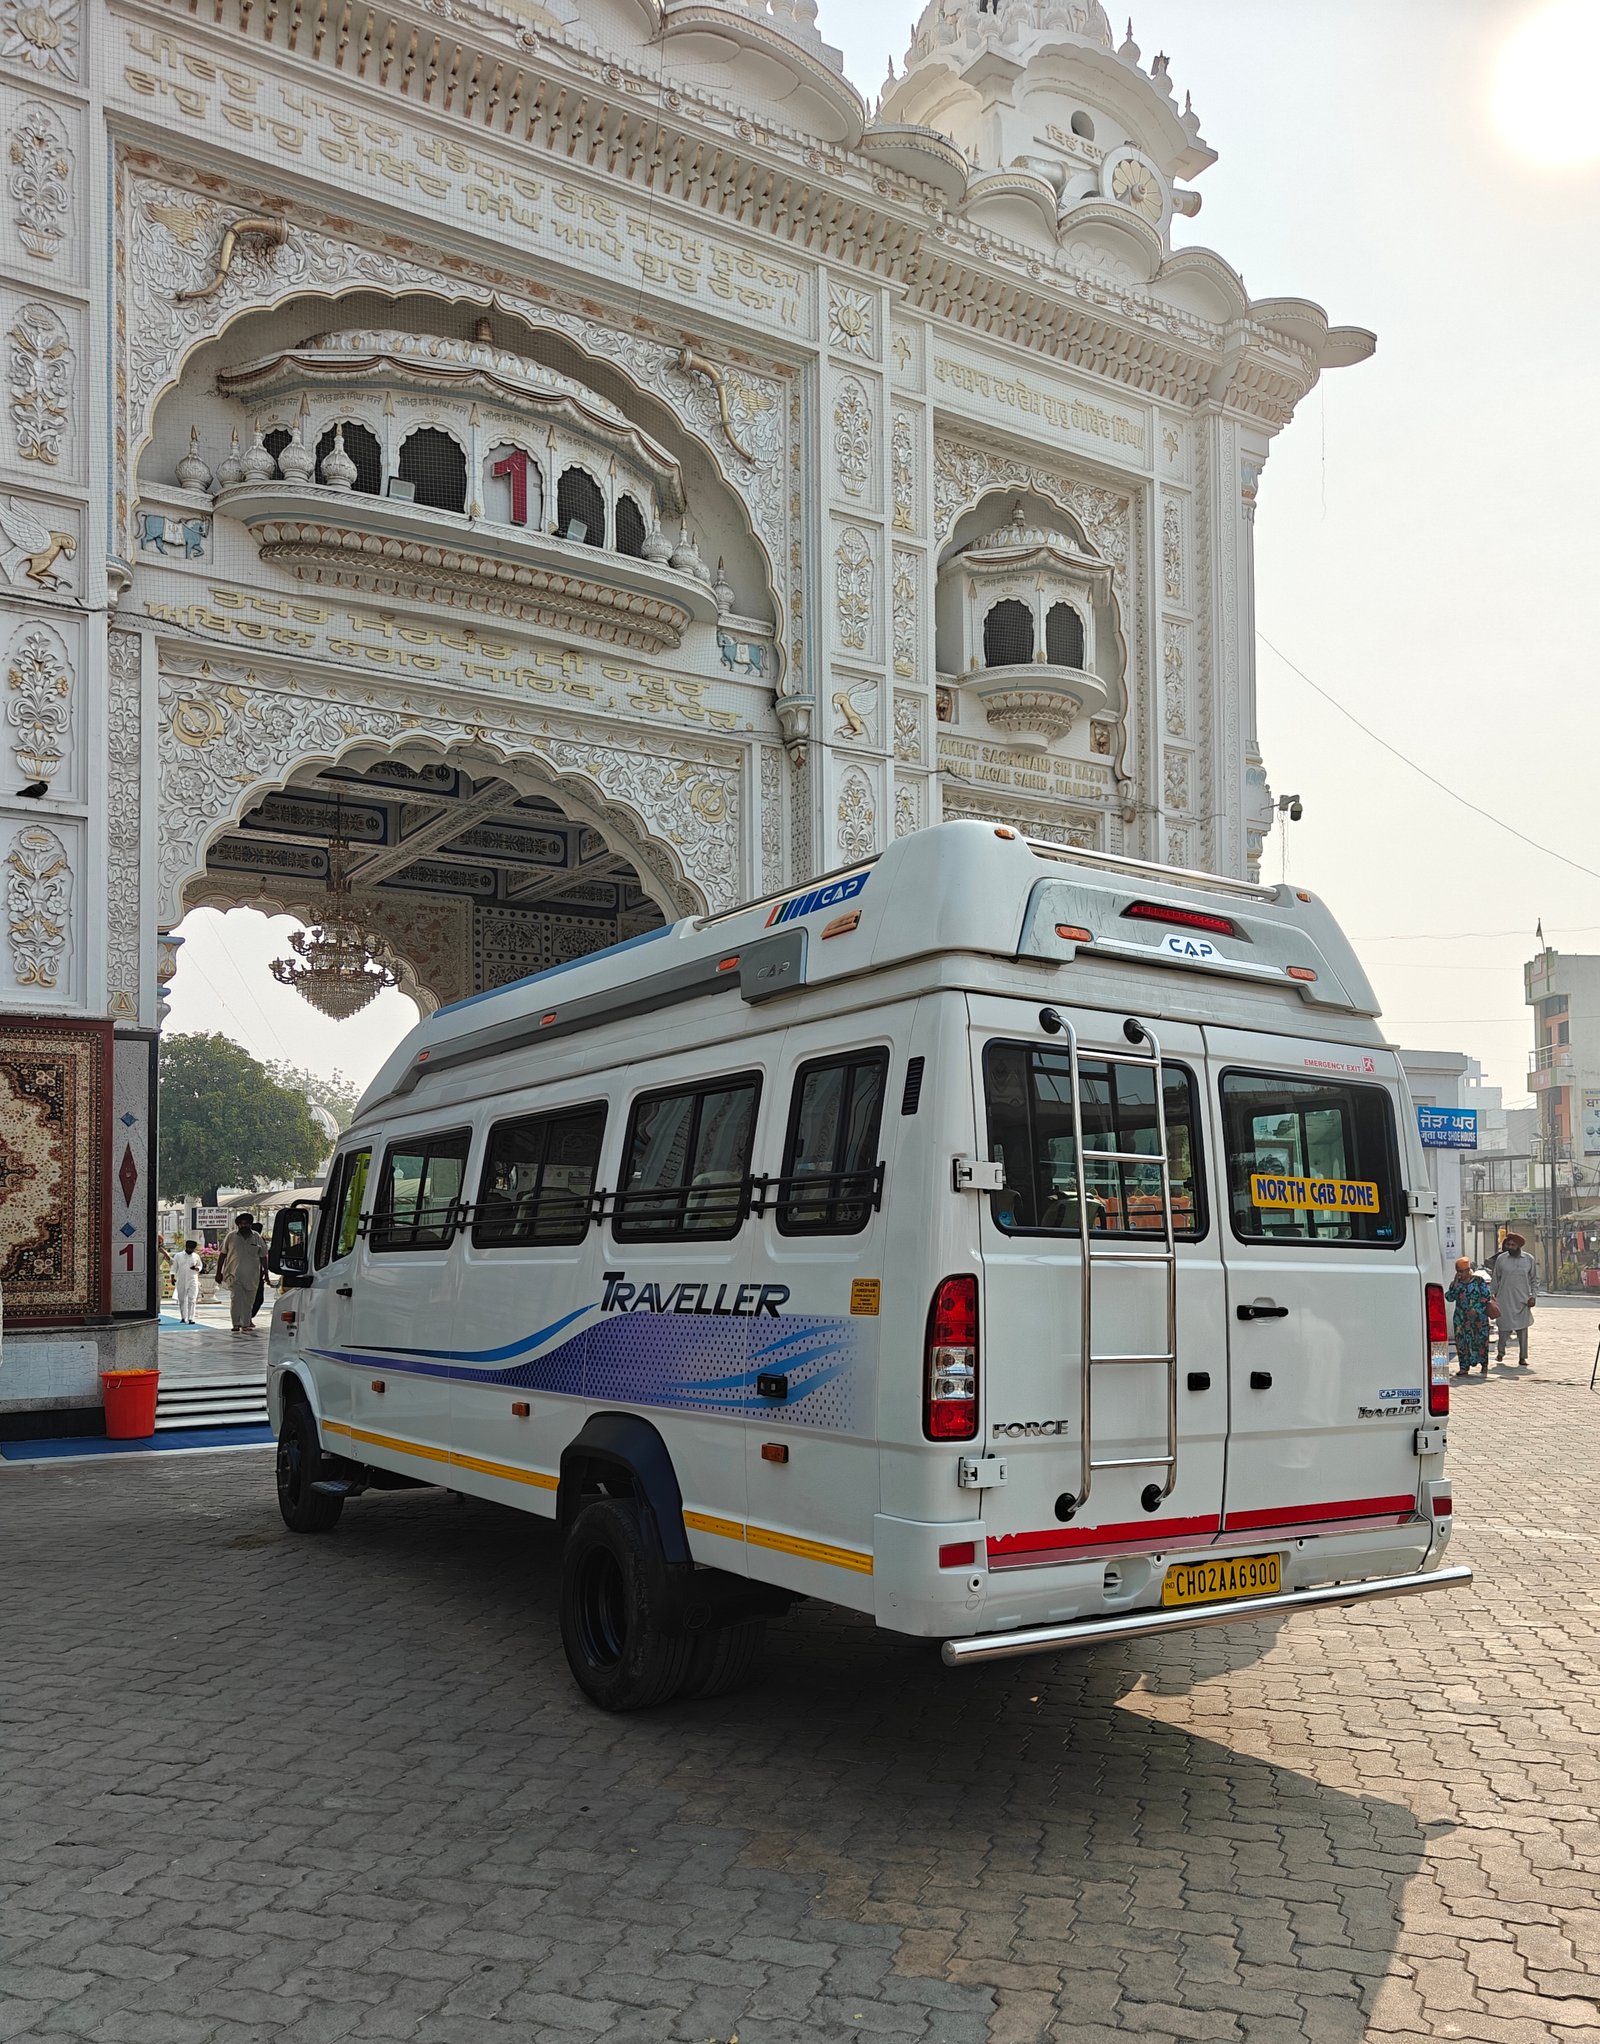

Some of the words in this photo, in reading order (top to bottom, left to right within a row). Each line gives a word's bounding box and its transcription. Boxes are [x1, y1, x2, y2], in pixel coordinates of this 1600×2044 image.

[126, 30, 263, 103] ਪੀਵਹੁ
[279, 87, 402, 148] ਪਾਹੁਲ
[124, 65, 210, 119] ਵਾਹੁ
[221, 101, 308, 154] ਵਾਹੁ
[462, 183, 542, 233] ਸਿੰਘ
[551, 218, 625, 261] ਆਪੇ
[491, 450, 528, 528] 1
[144, 600, 317, 648] ਅਬਿਚਲ
[326, 635, 449, 672] ਨਗਰ
[208, 586, 335, 625] ਤਖਤ
[347, 613, 518, 661] ਸੱਚਖੰਡ
[529, 649, 590, 679] ਸ੍ਰੀ
[975, 764, 1011, 784] NAGAR
[982, 747, 1051, 773] SACHKHAND
[1054, 760, 1072, 777] SRI
[1075, 765, 1109, 784] HAZUR
[821, 880, 859, 904] CAP
[1169, 938, 1213, 957] CAP
[757, 961, 791, 981] CAP
[1304, 1058, 1345, 1070] EMERGENCY
[1346, 1064, 1361, 1072] EXIT
[1420, 1108, 1449, 1128] ਜੋੜਾ
[1451, 1116, 1475, 1131] ਘਰ
[1437, 1131, 1447, 1141] घर
[1447, 1131, 1461, 1142] SHOE
[1461, 1131, 1477, 1143] HOUSE
[1256, 1178, 1307, 1204] NORTH
[1310, 1182, 1337, 1206] CAB
[1340, 1184, 1375, 1207] ZONE
[119, 1244, 134, 1271] 1
[600, 1271, 791, 1318] TRAVELLER
[992, 1419, 1069, 1439] FORCE
[1165, 1581, 1175, 1589] IND
[1176, 1561, 1278, 1597] CH02AA6900
